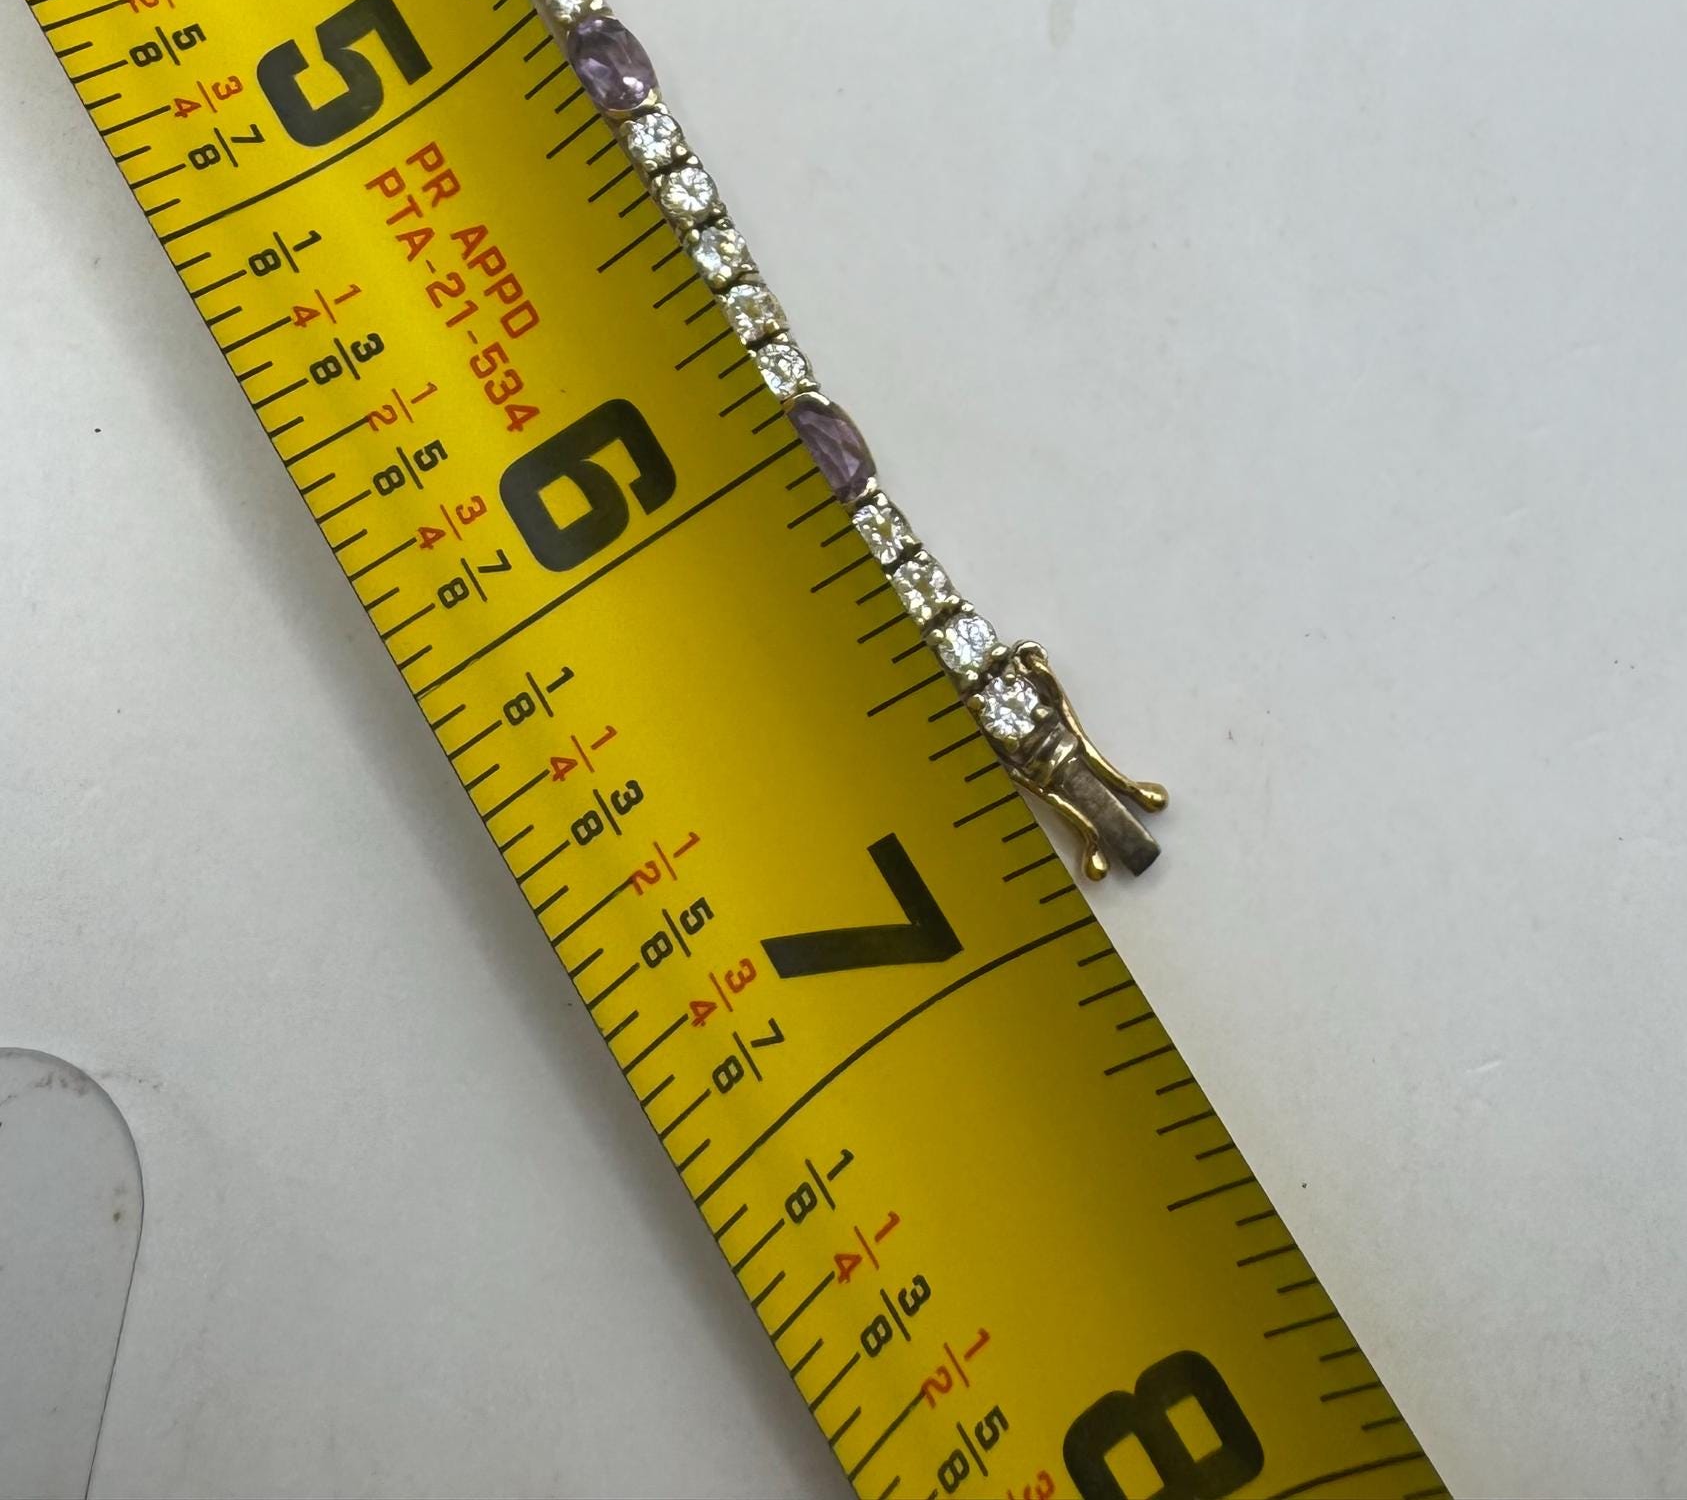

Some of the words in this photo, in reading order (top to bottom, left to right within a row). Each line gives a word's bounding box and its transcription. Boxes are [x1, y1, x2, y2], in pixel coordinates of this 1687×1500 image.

[365, 167, 540, 433] PTA-21-534
[406, 141, 461, 209] PR
[450, 224, 540, 339] APPD
[500, 398, 677, 572] 6
[761, 832, 964, 979] 7
[1063, 1350, 1264, 1500] 8
